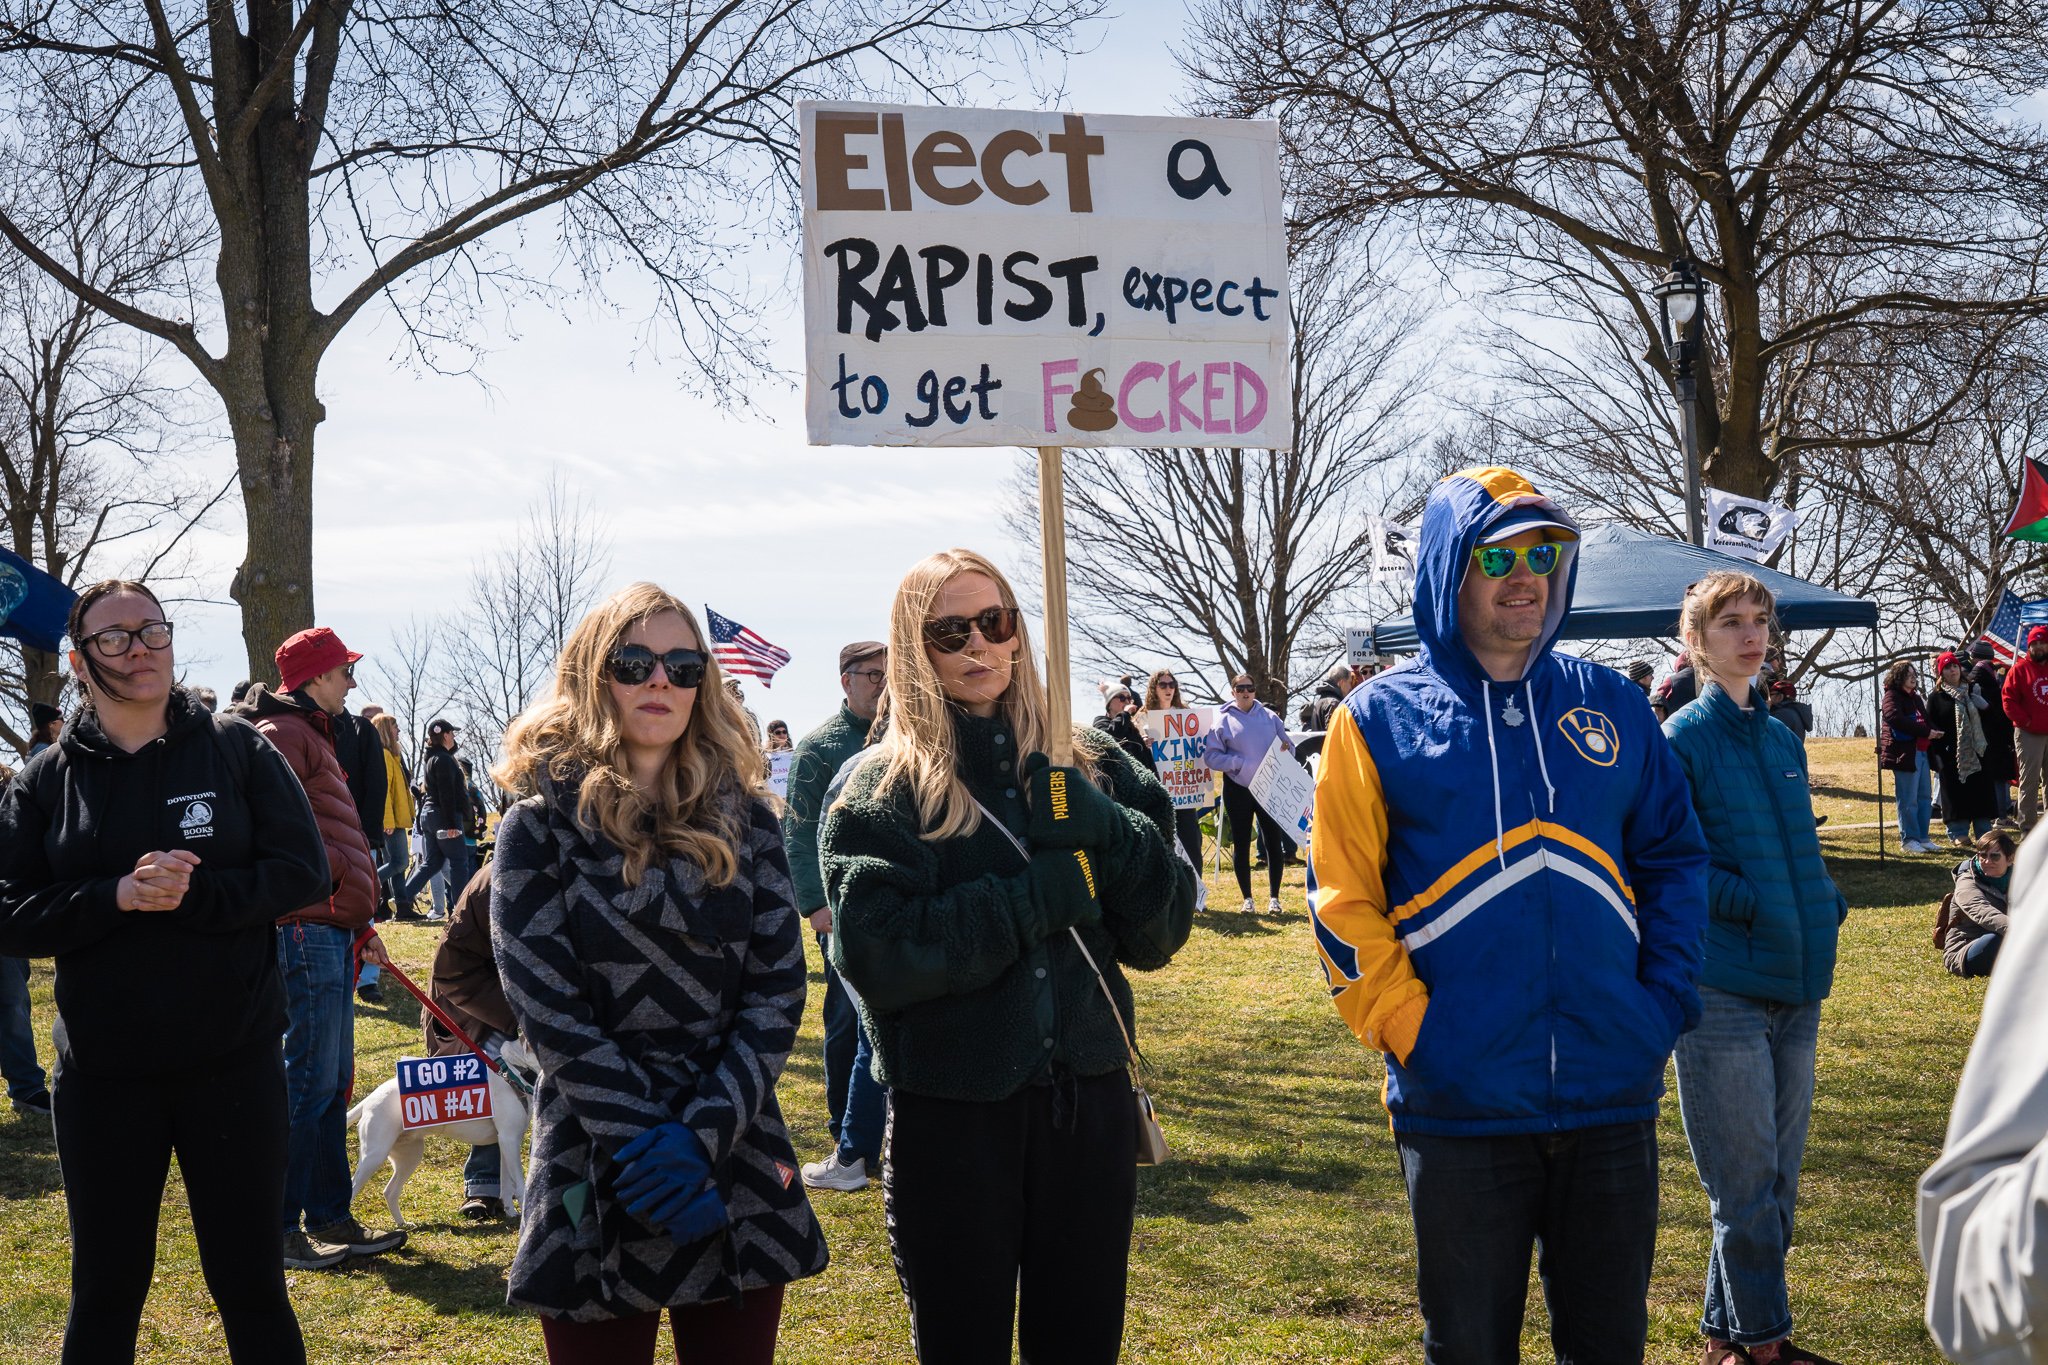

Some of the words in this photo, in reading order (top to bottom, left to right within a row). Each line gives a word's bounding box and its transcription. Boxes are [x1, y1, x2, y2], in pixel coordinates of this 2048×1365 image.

[815, 111, 1104, 213] Elect
[1167, 139, 1232, 200] a
[824, 237, 1105, 342] RAPIST,
[1122, 266, 1279, 324] expect
[830, 353, 889, 419] to
[906, 363, 1002, 428] get
[1041, 359, 1269, 434] FCKED
[1164, 713, 1199, 738] NO
[1162, 768, 1212, 785] MERICA
[1173, 760, 1194, 771] IN
[1252, 747, 1283, 803] HISTORY
[167, 791, 216, 805] DOWNTOWN
[1050, 771, 1069, 820] PACKERS
[1168, 785, 1199, 796] PROTECT
[1264, 792, 1282, 816] HAS
[1276, 775, 1292, 795] ITS
[1290, 780, 1307, 803] ON
[183, 826, 214, 836] BOOKS
[1073, 849, 1096, 899] PACKERS
[403, 1065, 411, 1088] I
[418, 1061, 447, 1086] GO
[453, 1058, 480, 1081] #2
[405, 1094, 438, 1124] ON
[444, 1088, 486, 1118] #47
